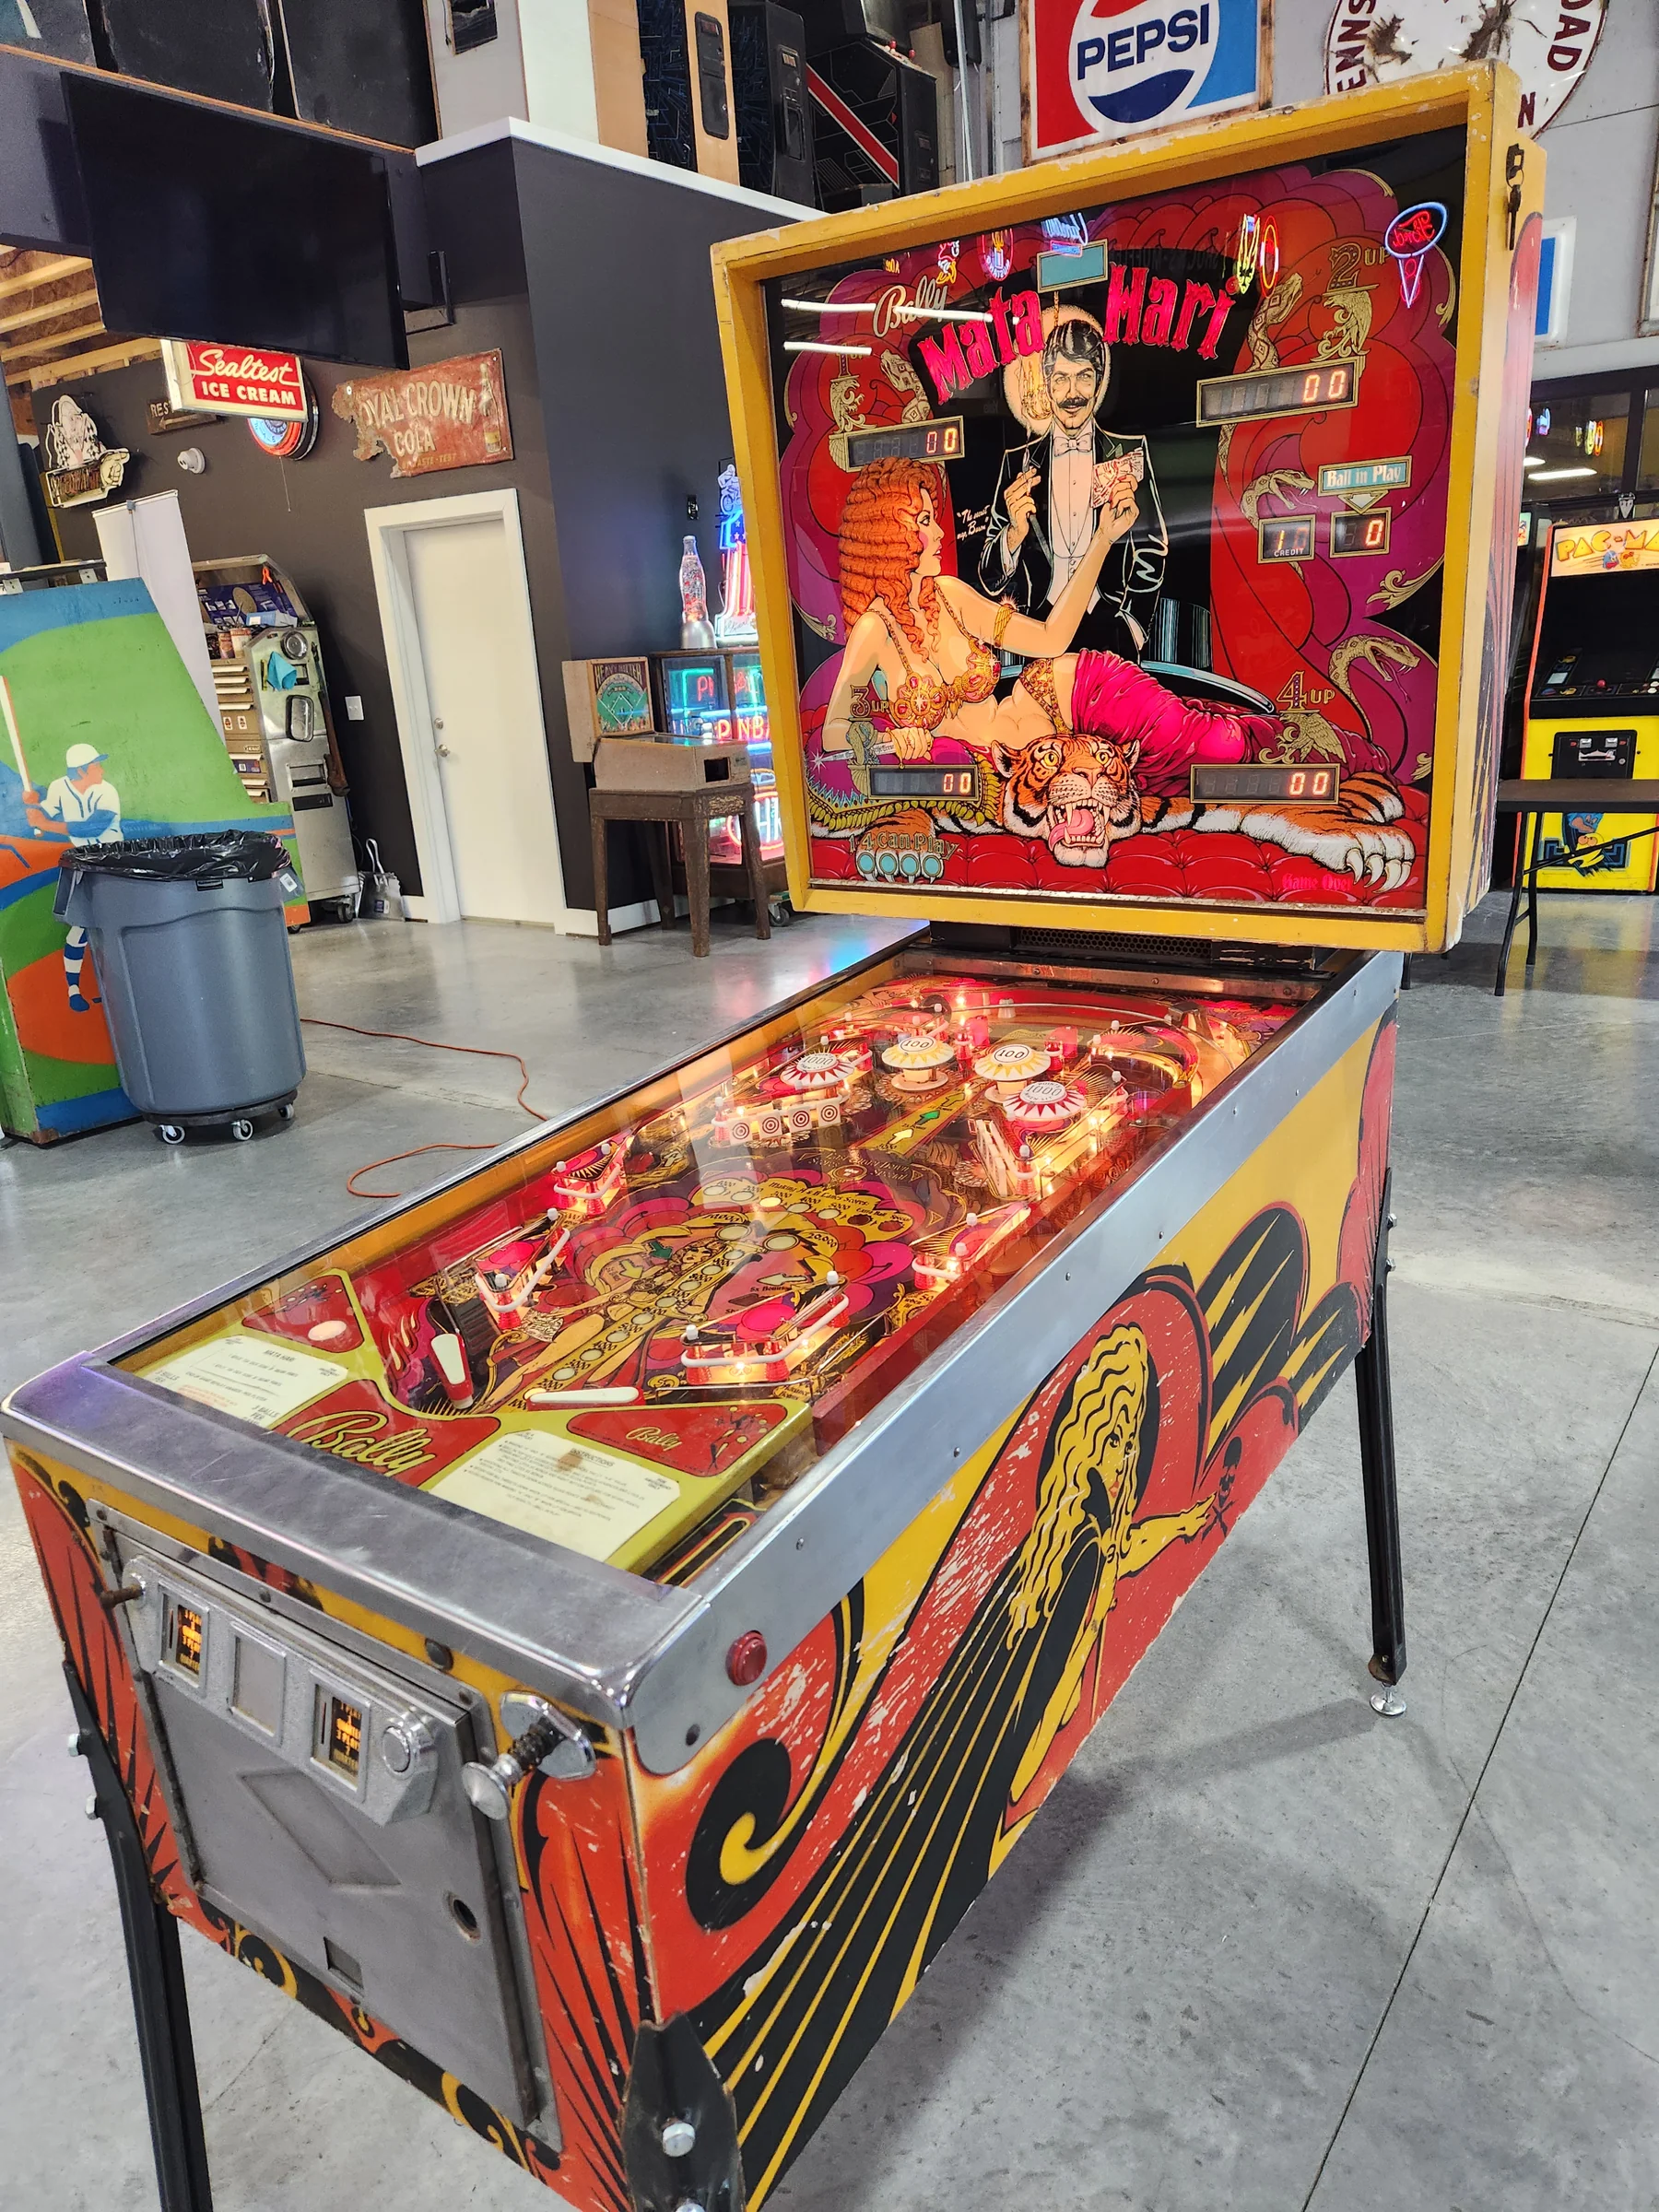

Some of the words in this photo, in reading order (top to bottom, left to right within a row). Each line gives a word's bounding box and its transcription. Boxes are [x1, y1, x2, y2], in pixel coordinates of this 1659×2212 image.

[1077, 3, 1209, 80] PEPSI
[874, 276, 947, 337] Bally
[917, 287, 1046, 405] Mata
[1102, 262, 1239, 360] Hari
[191, 349, 300, 386] Sealtest
[202, 382, 229, 397] ICE
[237, 385, 296, 406] CREAM
[1302, 371, 1347, 404] 00
[358, 387, 404, 429] OYAL
[406, 380, 476, 424] CROWN
[394, 427, 437, 456] COLA
[926, 428, 958, 453] 00
[1327, 470, 1351, 488] Ball
[1356, 469, 1368, 484] in
[1372, 464, 1403, 484] Play
[1274, 547, 1304, 558] CREDIT
[872, 699, 888, 712] UP
[1310, 688, 1335, 704] UP
[943, 772, 971, 794] 00
[1289, 772, 1329, 795] 00
[877, 832, 910, 849] Can
[914, 833, 959, 860] Play
[1282, 873, 1318, 890] Game
[904, 1041, 930, 1049] 100
[998, 1050, 1025, 1059] 100
[804, 1055, 834, 1065] 1000
[1027, 1085, 1063, 1097] 1000
[806, 1232, 837, 1248] 20,000
[286, 1411, 436, 1477] Bally
[626, 1426, 682, 1452] Bally
